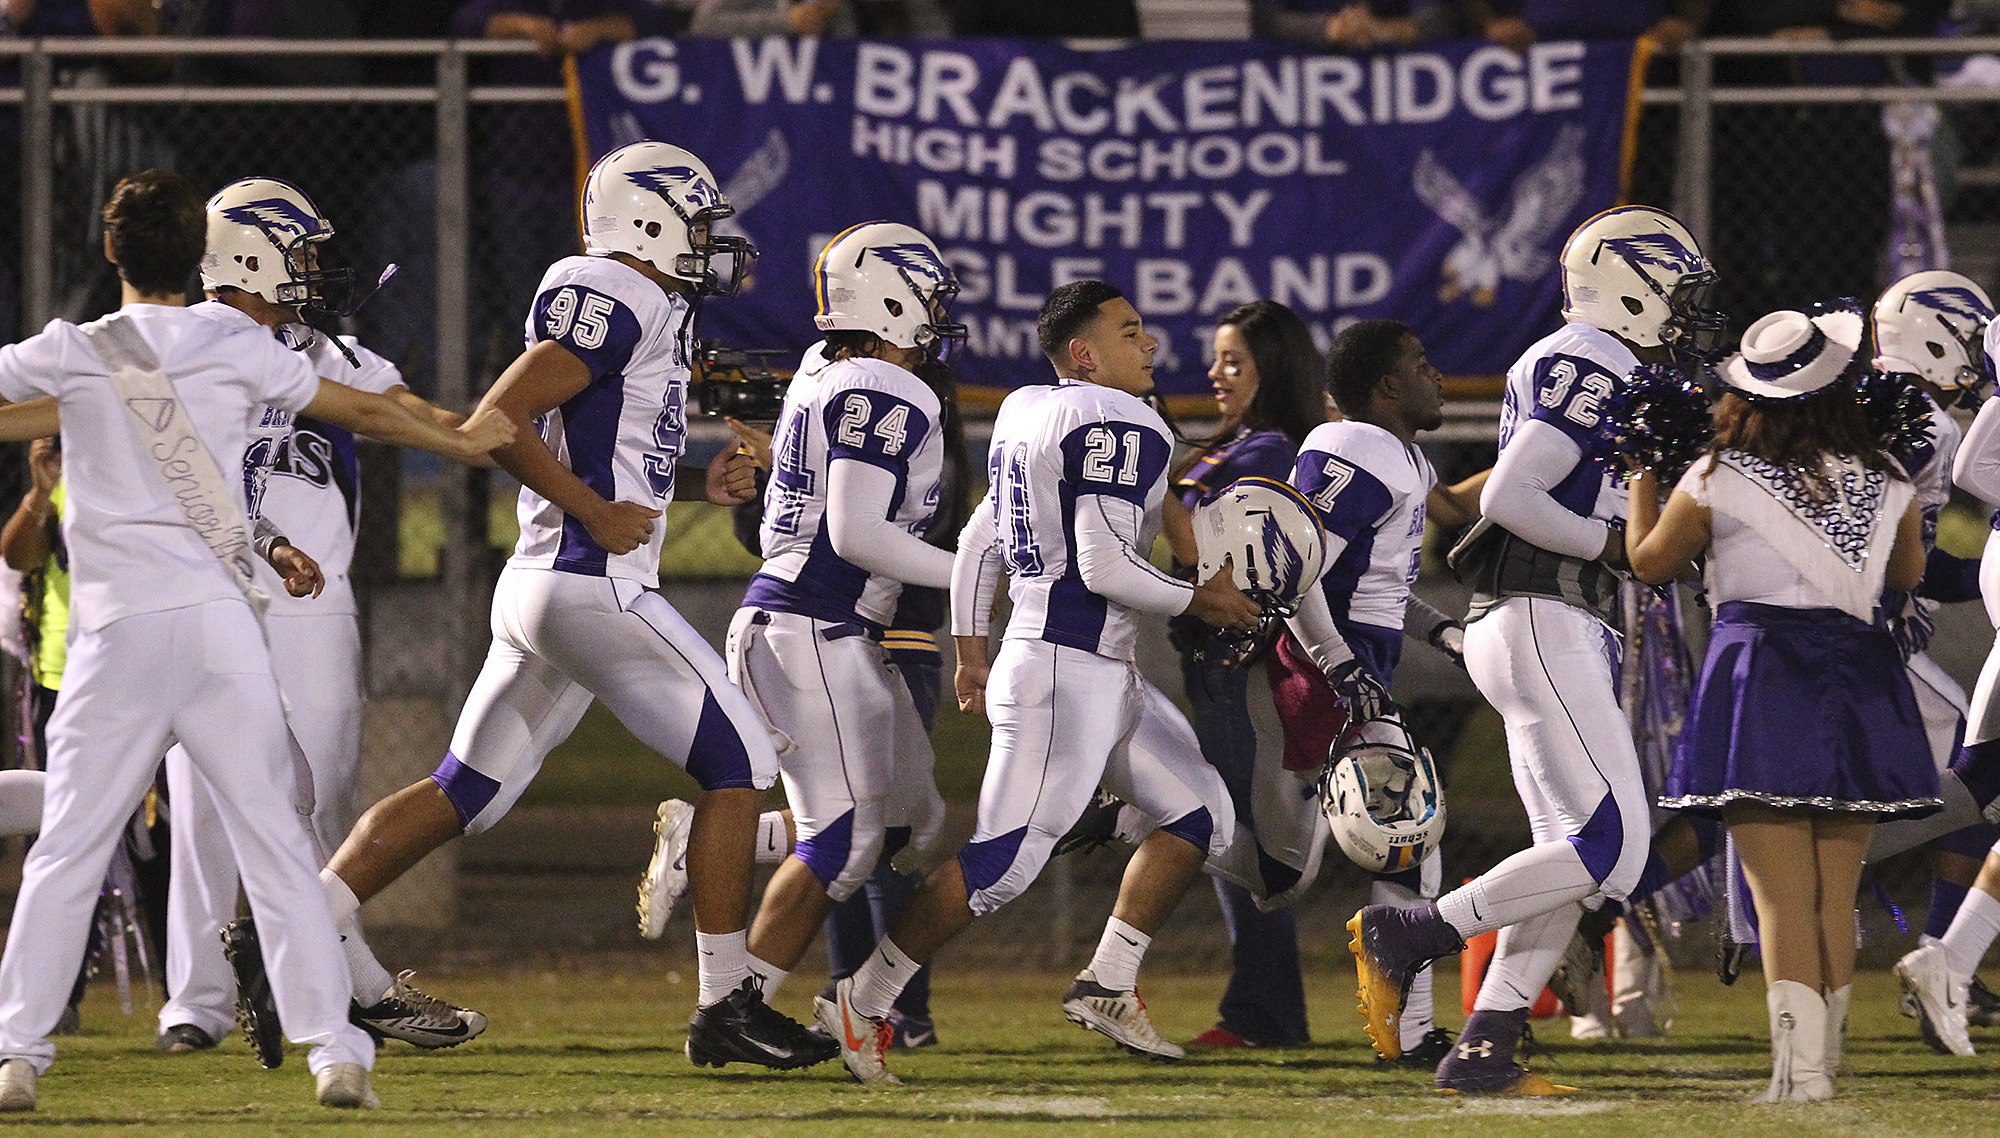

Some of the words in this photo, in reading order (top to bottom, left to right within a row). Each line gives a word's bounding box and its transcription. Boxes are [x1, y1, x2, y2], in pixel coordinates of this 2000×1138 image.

[611, 36, 702, 104] G.
[731, 34, 835, 104] W.
[854, 40, 1587, 135] BRACKENRIDGE
[852, 114, 1017, 179] HIGH
[1038, 132, 1347, 182] SCHOOL
[916, 179, 1272, 248] MIGHTY
[1135, 251, 1393, 317] BAND
[546, 286, 616, 351] 95
[837, 392, 911, 456] 24
[1538, 358, 1616, 429] 32
[1081, 426, 1141, 487] 21
[1312, 457, 1356, 514] 7
